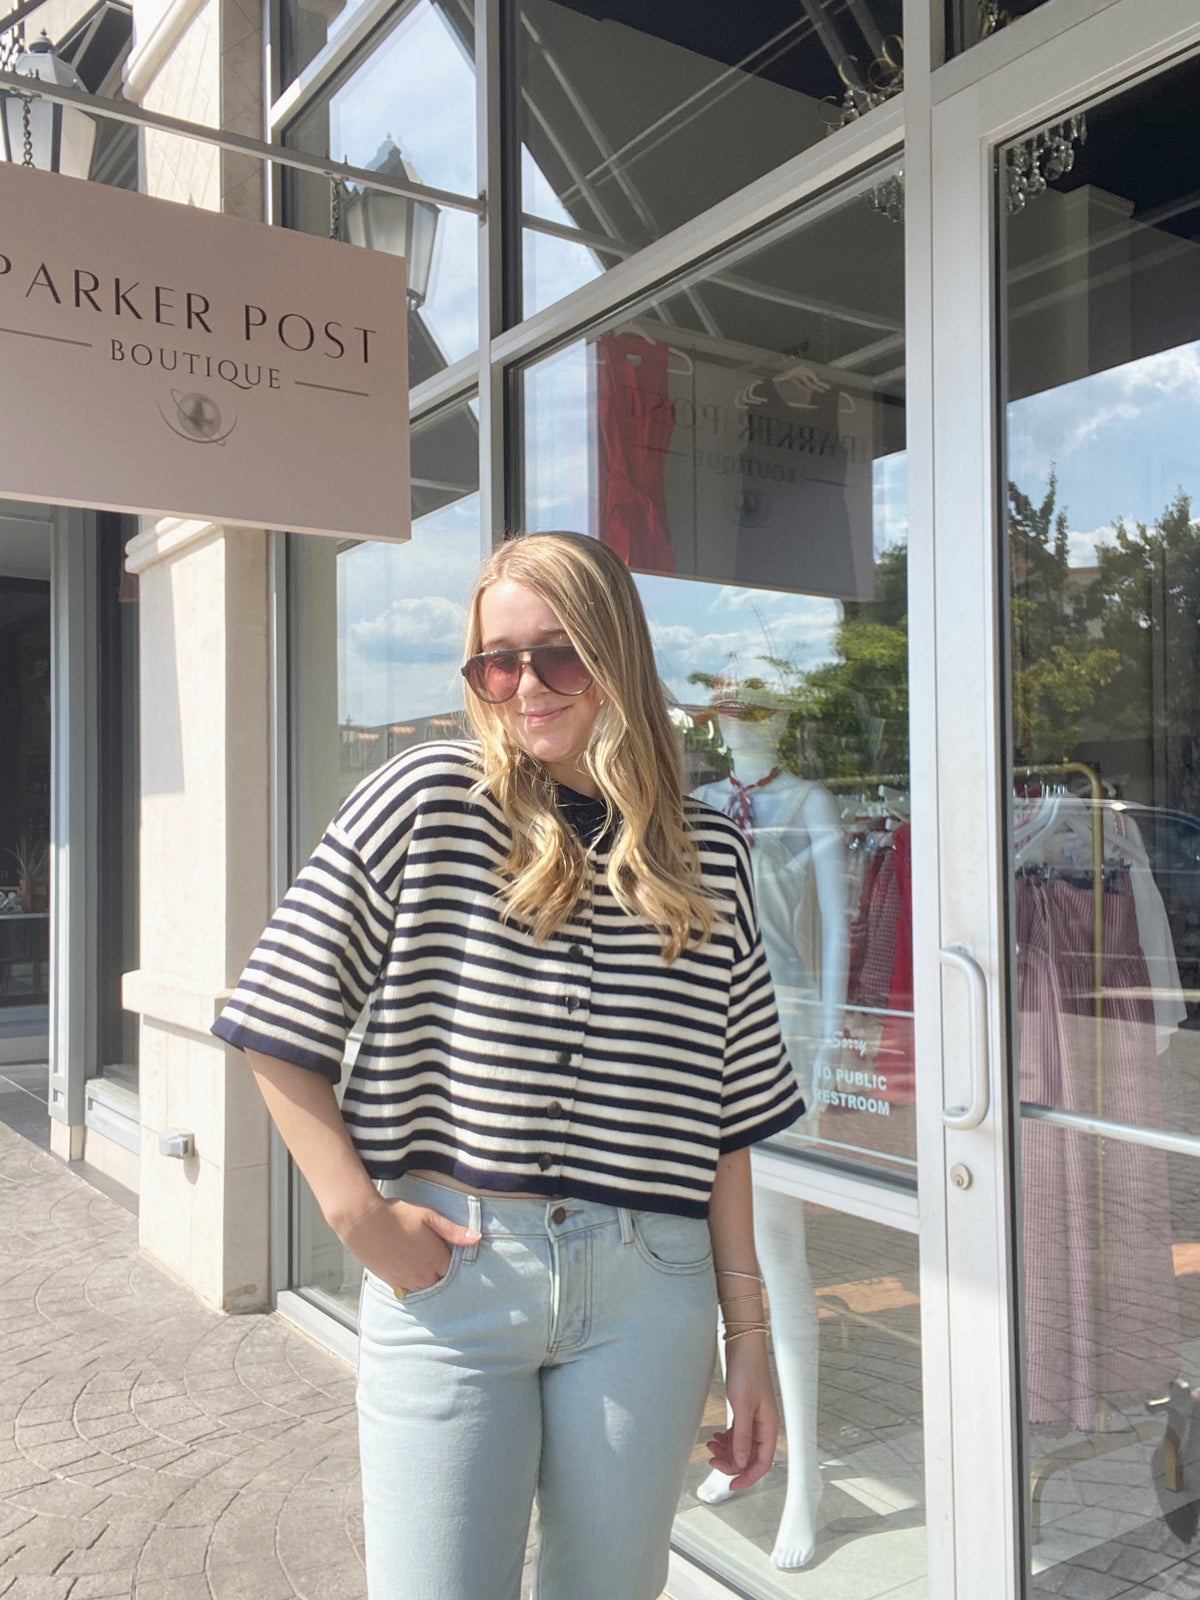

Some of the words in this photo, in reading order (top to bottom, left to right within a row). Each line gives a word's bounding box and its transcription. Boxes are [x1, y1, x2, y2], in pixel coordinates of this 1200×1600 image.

[243, 303, 377, 364] POST
[110, 338, 281, 390] BOUTIQUE
[832, 1031, 866, 1056] Sorry
[835, 1068, 887, 1090] PUBLIC
[813, 1088, 890, 1115] RESTROOM
